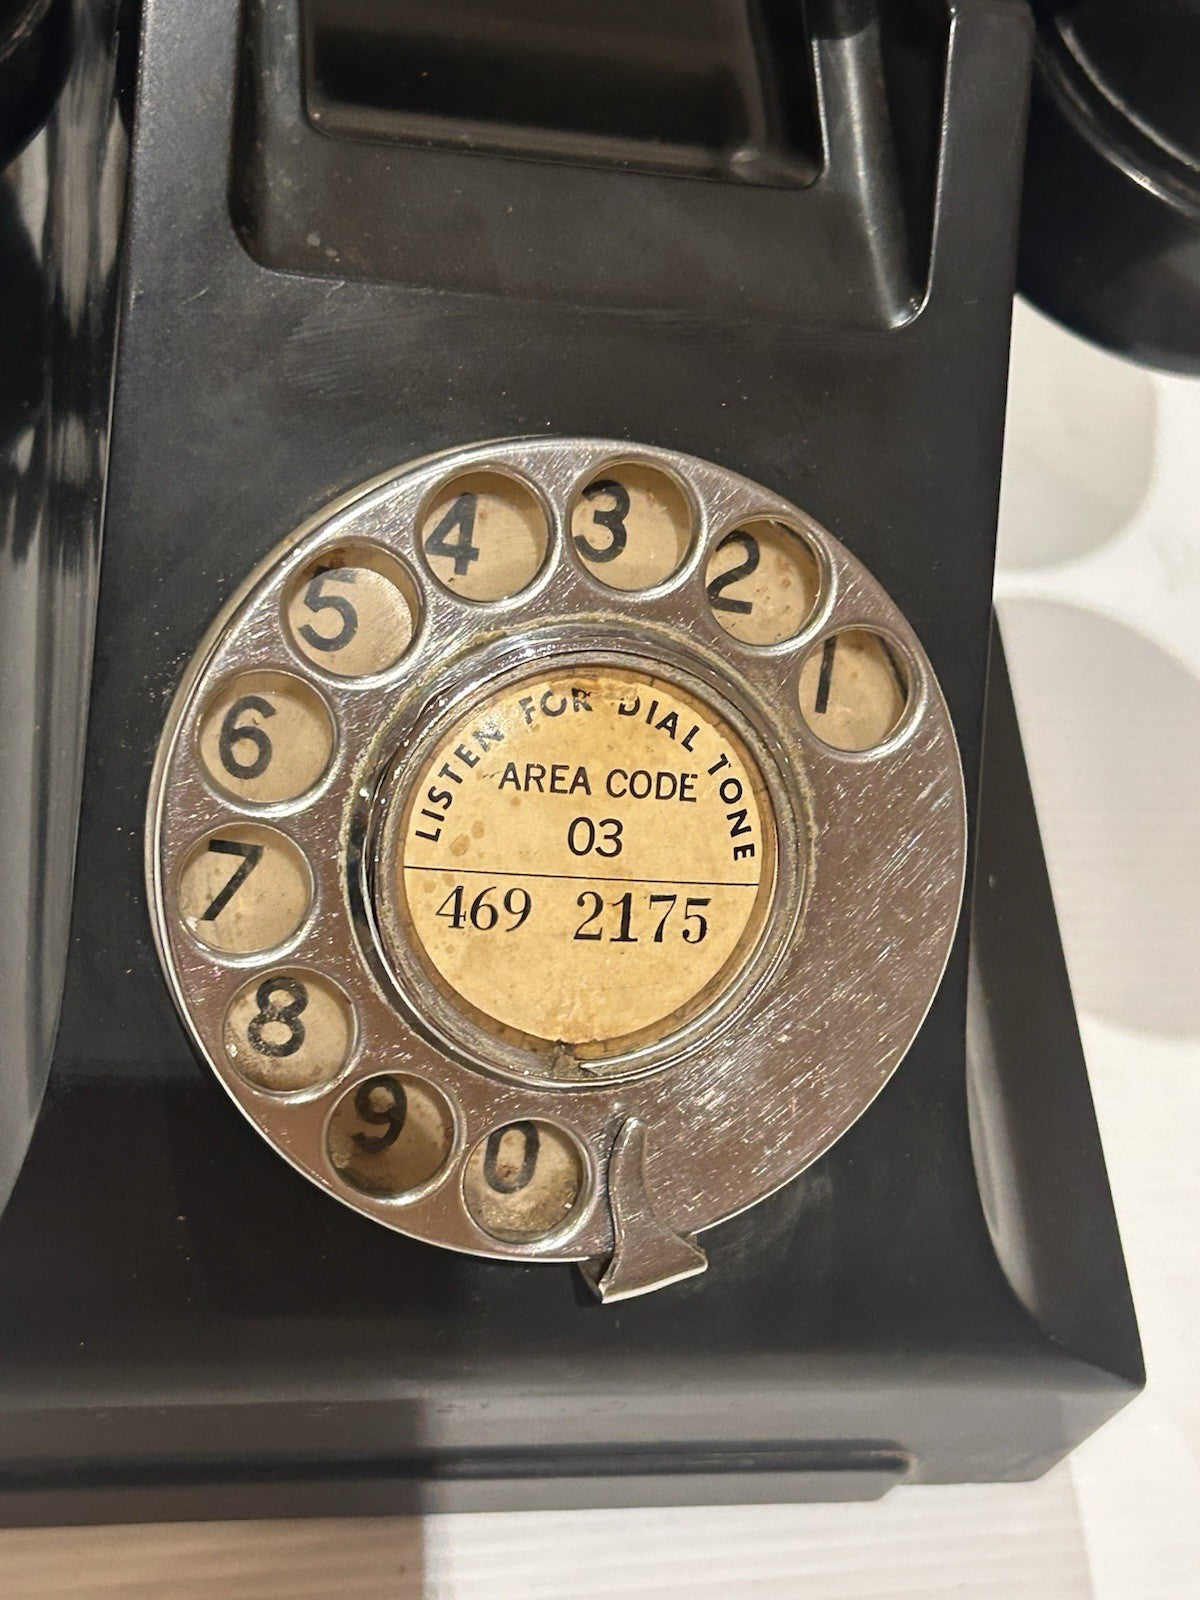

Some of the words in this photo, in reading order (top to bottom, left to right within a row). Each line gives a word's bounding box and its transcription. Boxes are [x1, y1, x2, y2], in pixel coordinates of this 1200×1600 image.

[424, 492, 480, 576] 4
[573, 479, 631, 563] 3
[297, 565, 359, 652] 5
[706, 530, 760, 615] 2
[814, 635, 837, 714] 1
[219, 695, 277, 780] 6
[415, 720, 506, 842] LISTEN
[519, 687, 594, 724] FOR
[618, 695, 700, 752] DIAL
[708, 753, 755, 861] TONE
[498, 762, 592, 796] AREA
[606, 768, 698, 803] CODE
[567, 815, 624, 858] 03
[200, 838, 265, 922] 7
[436, 885, 533, 933] 469
[573, 890, 712, 944] 2175
[247, 975, 309, 1058] 8
[354, 1075, 408, 1153] 9
[484, 1120, 540, 1194] 0
